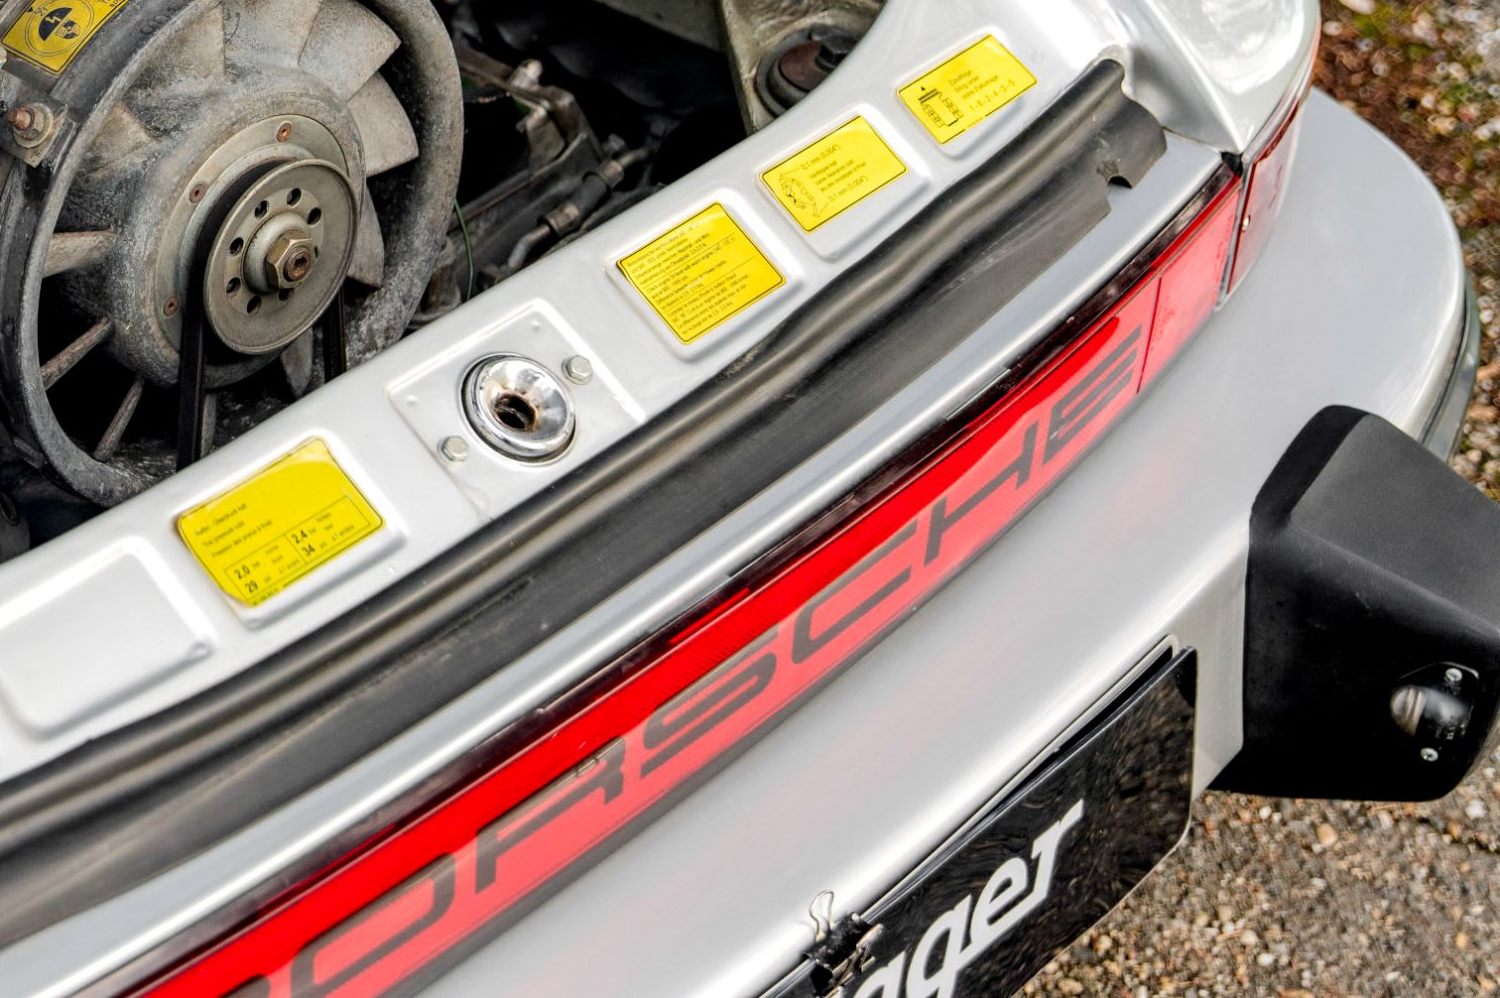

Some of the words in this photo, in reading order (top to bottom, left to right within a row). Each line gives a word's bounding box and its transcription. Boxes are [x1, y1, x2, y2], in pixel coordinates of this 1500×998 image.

[244, 579, 259, 593] 29
[301, 543, 315, 556] 34
[218, 323, 1142, 998] ORSCHE
[835, 799, 1084, 998] ager
